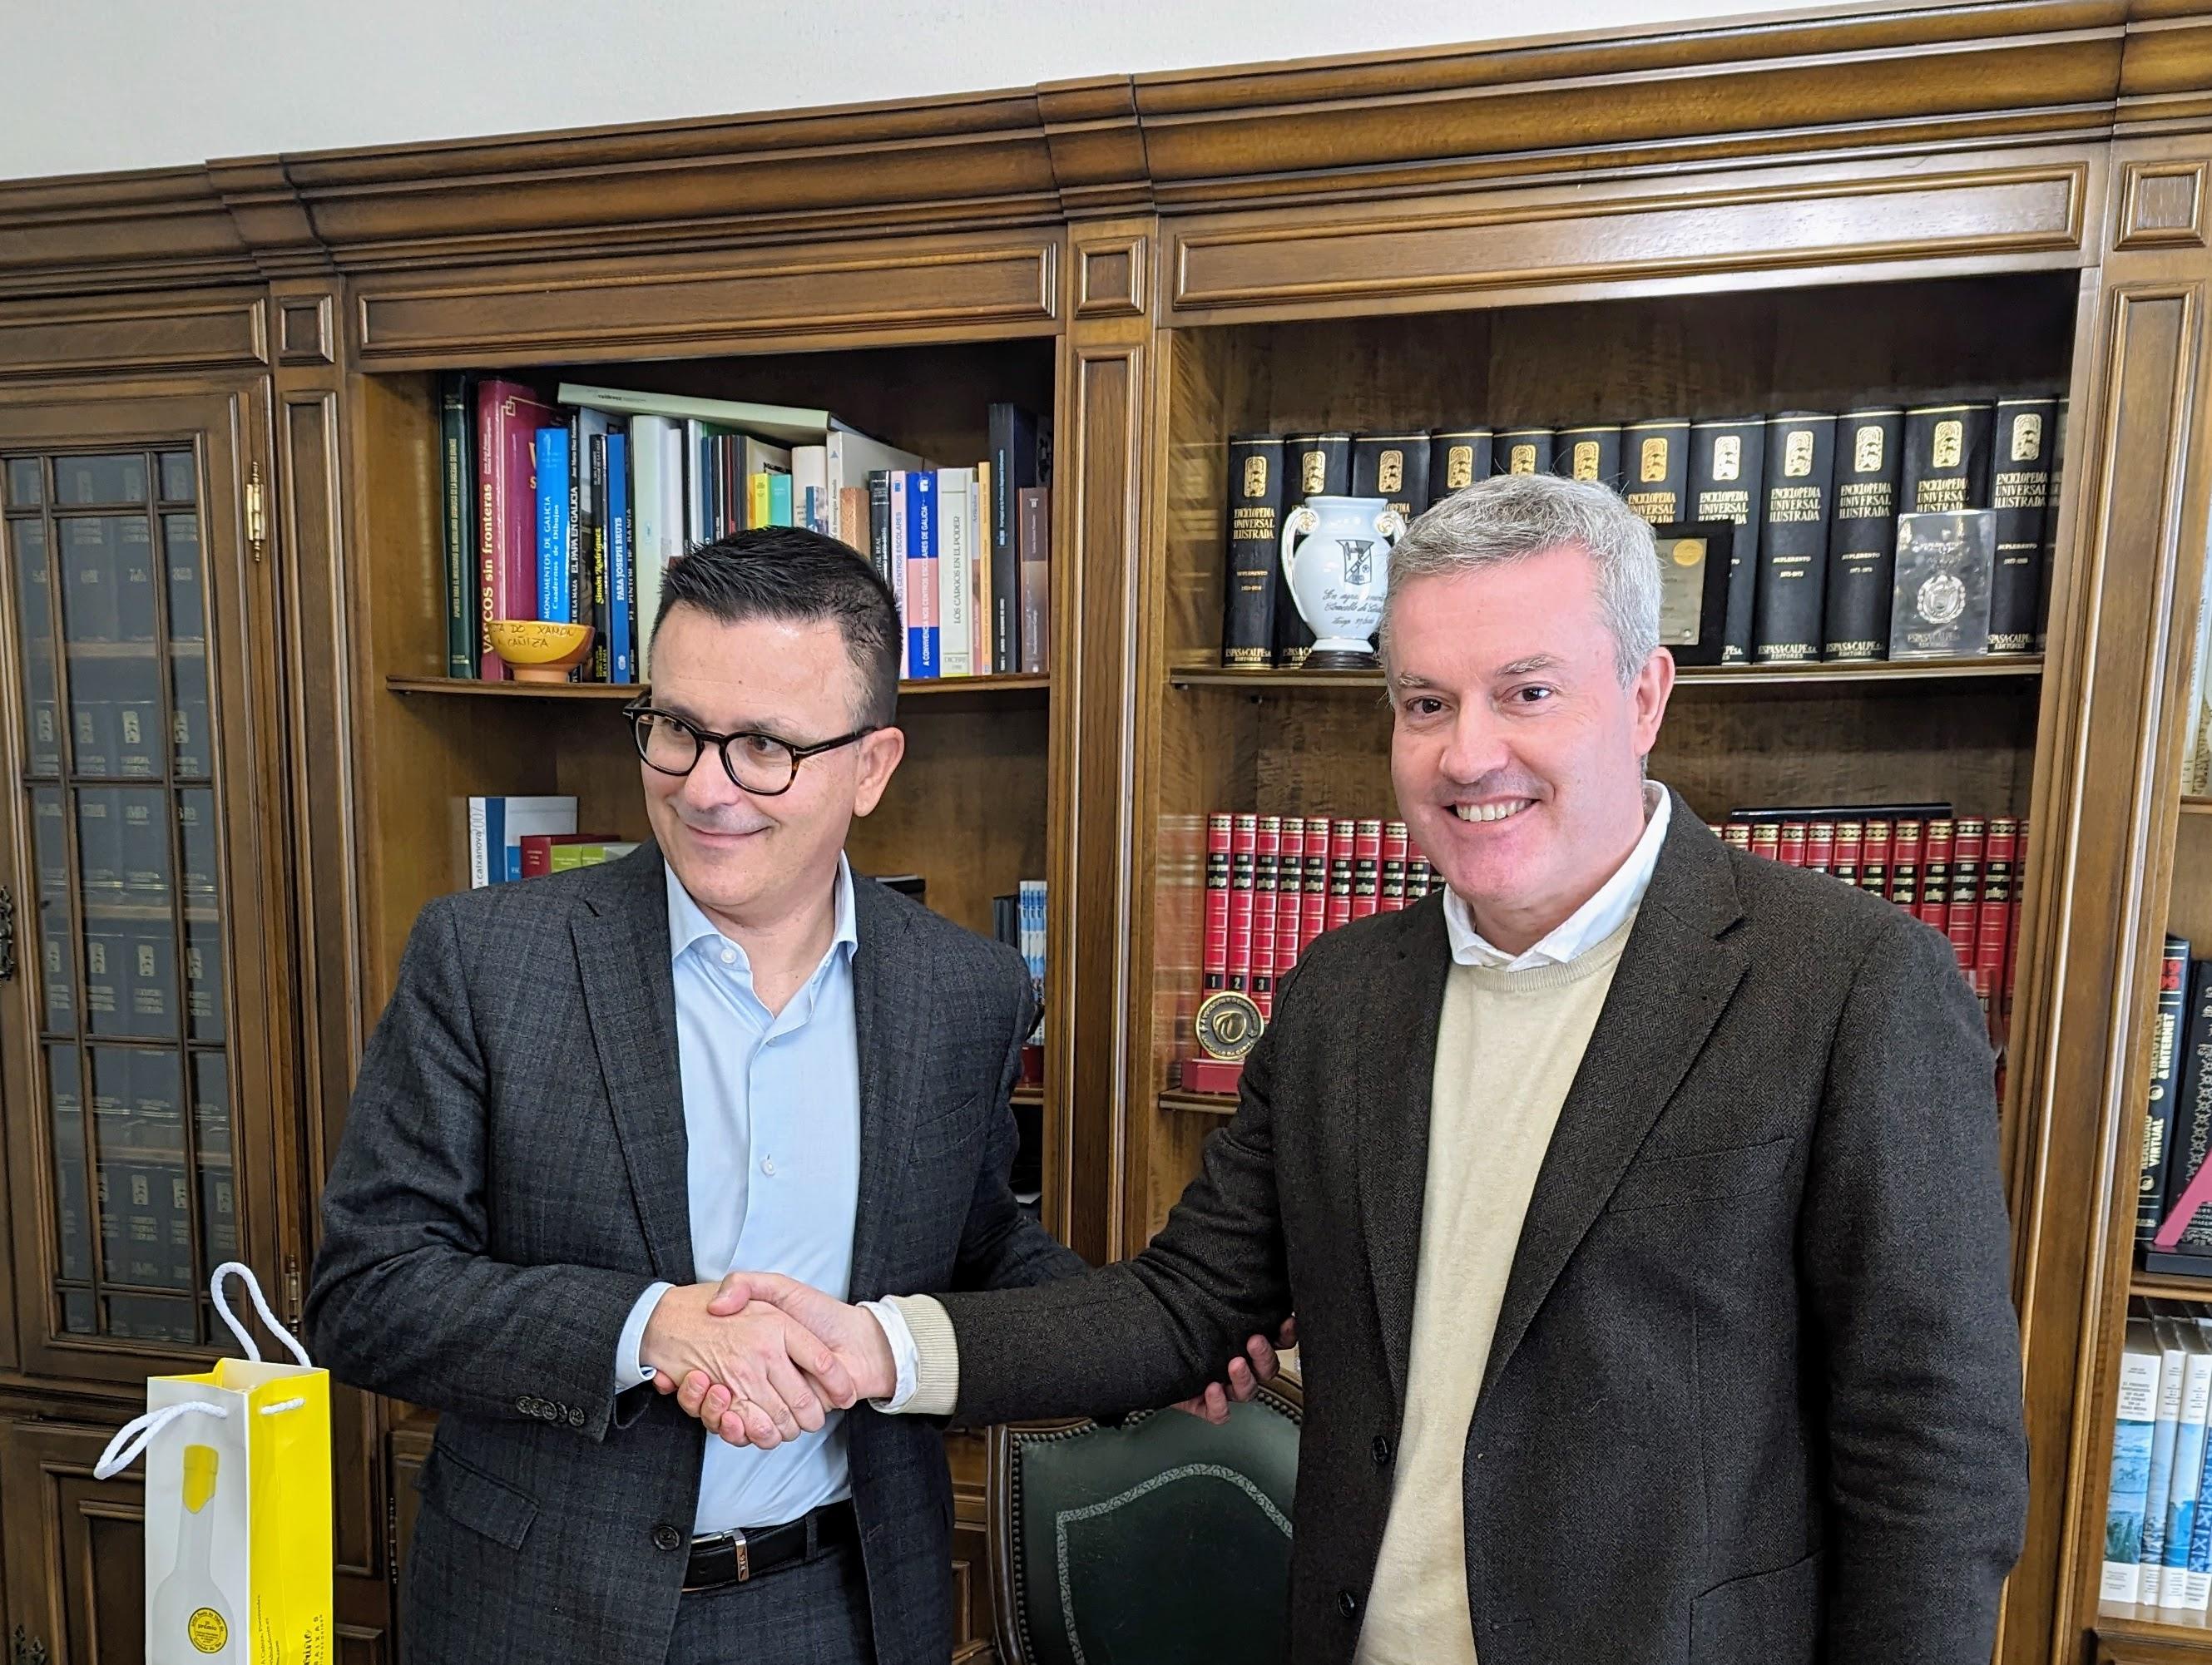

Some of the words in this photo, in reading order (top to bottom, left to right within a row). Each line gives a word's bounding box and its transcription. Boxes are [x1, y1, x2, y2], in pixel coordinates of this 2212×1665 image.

[1997, 472, 2047, 485] ENCICLOPEDIA
[1771, 487, 1821, 499] ENCICLOPEDIA
[1841, 482, 1892, 496] ENCICLOPEDIA
[1996, 484, 2047, 497] UNIVERSAL
[1628, 492, 1676, 504] ENCICLOPEDIA
[1700, 491, 1749, 503] ENCICLOPEDIA
[1840, 494, 1891, 507] UNIVERSAL
[1994, 497, 2046, 508] ILUSTRADA
[1699, 502, 1749, 515] UNIVERSAL
[1770, 498, 1821, 511] UNIVERSAL
[1916, 502, 1963, 512] ILUSTRAD
[482, 484, 492, 554] fronteras
[1769, 510, 1820, 522] ILUSTRADA
[1838, 506, 1890, 519] ILUSTRADA
[552, 504, 560, 540] Dibujos
[1234, 518, 1275, 529] UNIVERSAL
[571, 524, 578, 537] EN
[615, 517, 624, 545] BEUYS
[894, 511, 903, 553] ESCOLARES
[921, 531, 928, 540] DE
[1233, 529, 1274, 540] ILUSTRADA
[543, 537, 551, 549] DE
[552, 545, 559, 556] de
[593, 527, 604, 575] Rodríguez
[953, 546, 961, 556] EL
[616, 546, 625, 579] JOSEPH
[921, 541, 929, 576] ESCOLARES
[953, 557, 961, 569] EN
[482, 559, 492, 581] sin
[571, 561, 578, 574] EL
[595, 576, 605, 605] Simón
[616, 580, 625, 600] PARA
[922, 606, 930, 620] NOS
[953, 608, 962, 624] LOS
[471, 805, 485, 834] 2007
[475, 832, 483, 880] caixanova
[1211, 976, 1216, 988] 1
[1234, 976, 1240, 990] 2
[1258, 978, 1264, 991] 3
[2159, 1012, 2175, 1069] INTERNET
[2157, 1070, 2170, 1080] &
[2148, 1118, 2165, 1167] VIRTUAL
